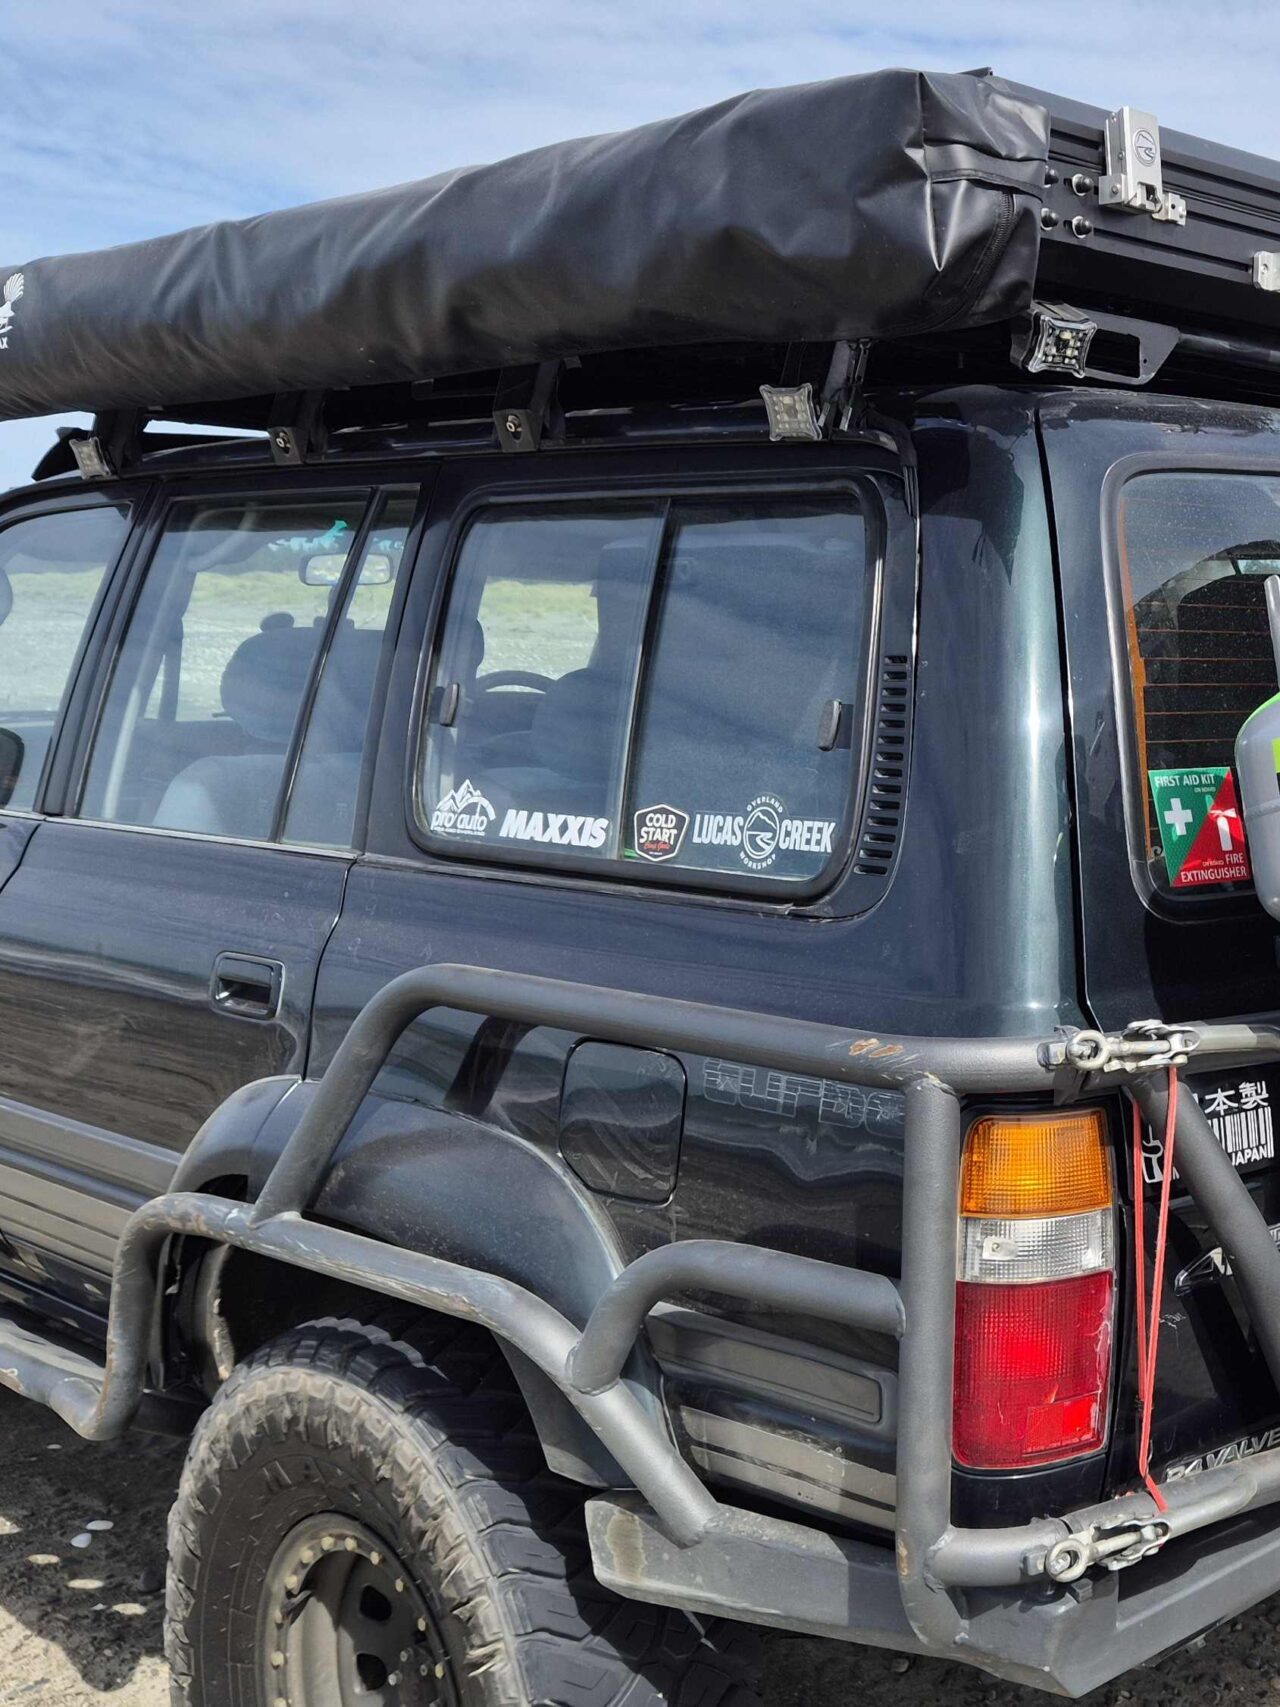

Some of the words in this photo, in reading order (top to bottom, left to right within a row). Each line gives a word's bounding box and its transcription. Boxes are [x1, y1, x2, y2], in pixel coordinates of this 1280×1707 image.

[1154, 775, 1180, 788] FIRST
[1183, 774, 1200, 785] AID
[1201, 774, 1215, 784] KIT
[746, 796, 783, 813] OVERLAND
[431, 811, 455, 831] pro
[457, 812, 488, 832] auto
[499, 808, 609, 848] MAXXIS
[645, 813, 676, 829] COLD
[639, 828, 678, 845] START
[692, 813, 744, 846] LUCAS
[778, 819, 836, 853] CREEK
[739, 850, 777, 870] WORKSHOP
[1225, 853, 1245, 865] FIRE
[1180, 866, 1247, 883] EXTINGUISHER
[1192, 1081, 1270, 1116] 本製
